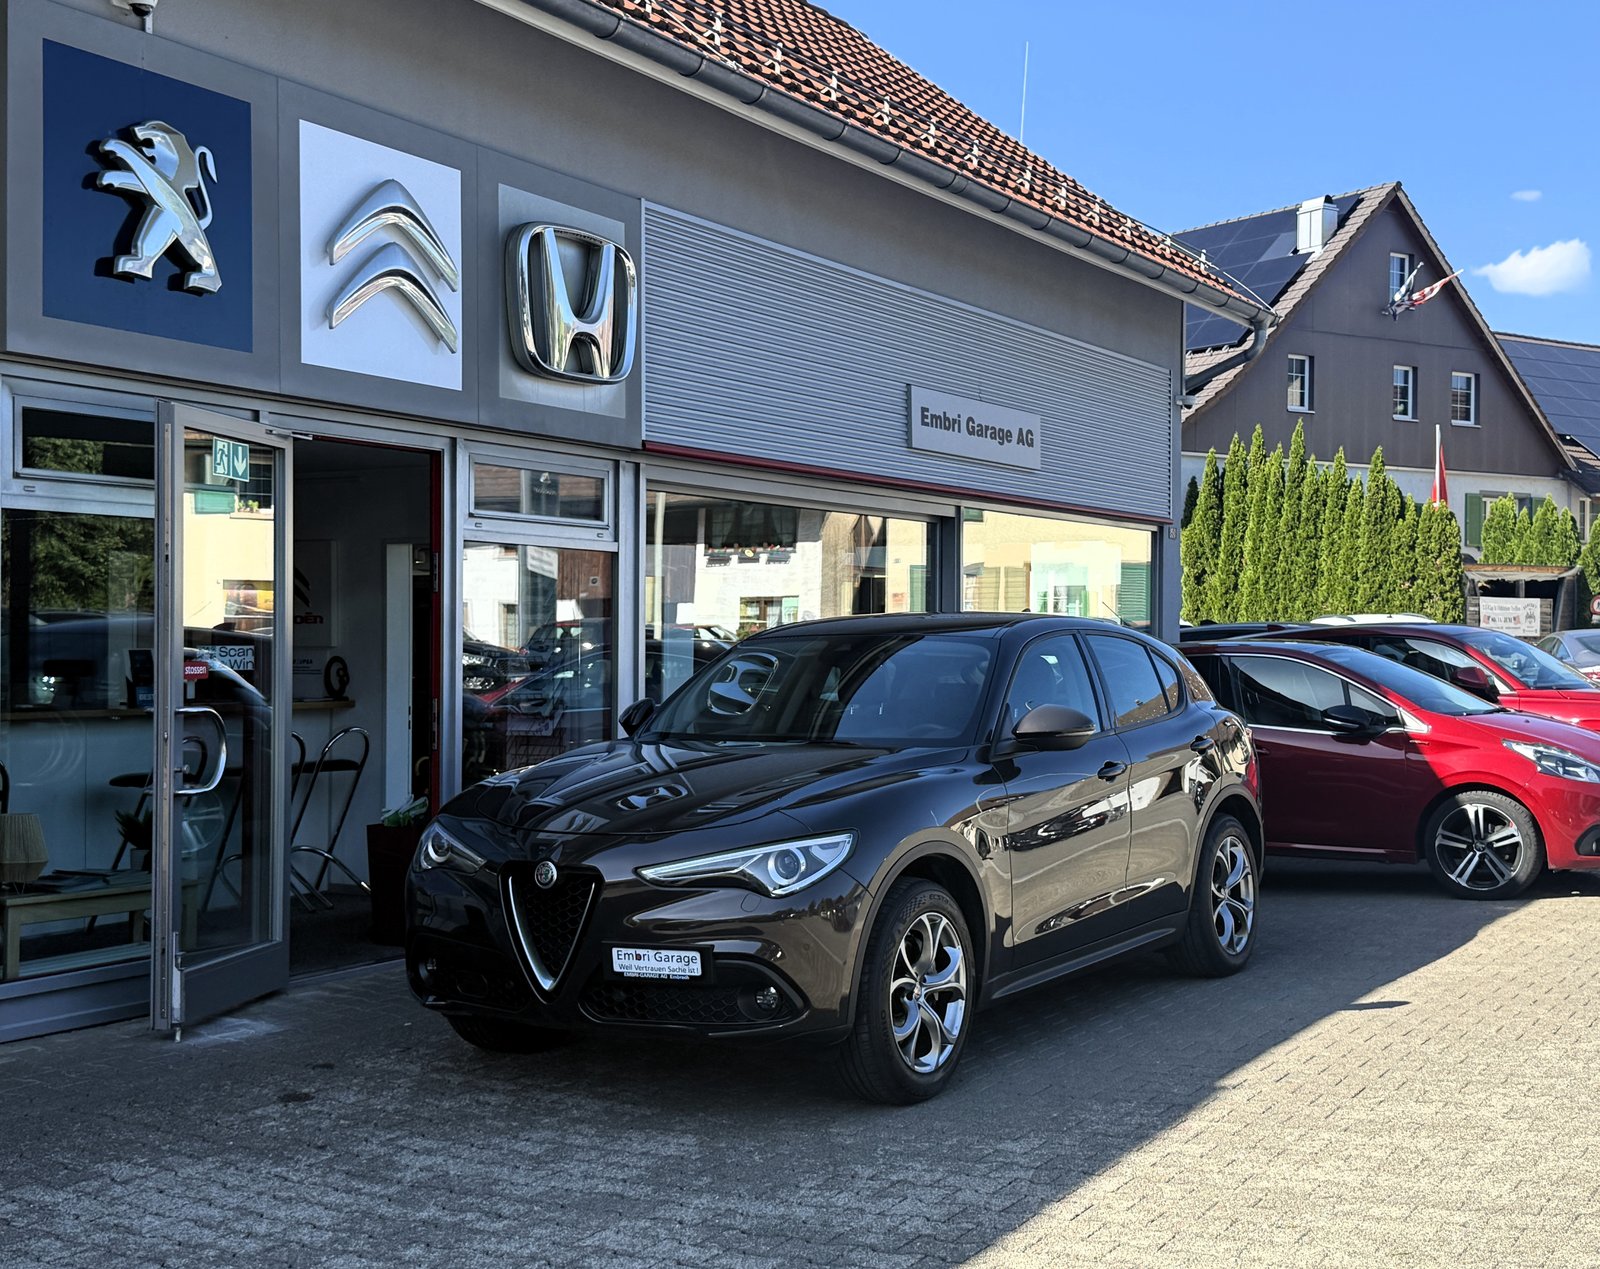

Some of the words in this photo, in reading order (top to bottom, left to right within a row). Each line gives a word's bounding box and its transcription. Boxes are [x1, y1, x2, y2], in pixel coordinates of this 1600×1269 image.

[920, 406, 962, 433] Embri
[965, 416, 1013, 446] Garage
[1016, 427, 1035, 448] AG
[219, 646, 255, 657] Scan
[229, 658, 255, 669] Win
[184, 666, 207, 675] stossen
[616, 949, 650, 961] Embri
[653, 951, 698, 966] Garage
[618, 963, 633, 971] Weil
[634, 964, 667, 973] Vertrauen
[667, 966, 687, 974] Sache
